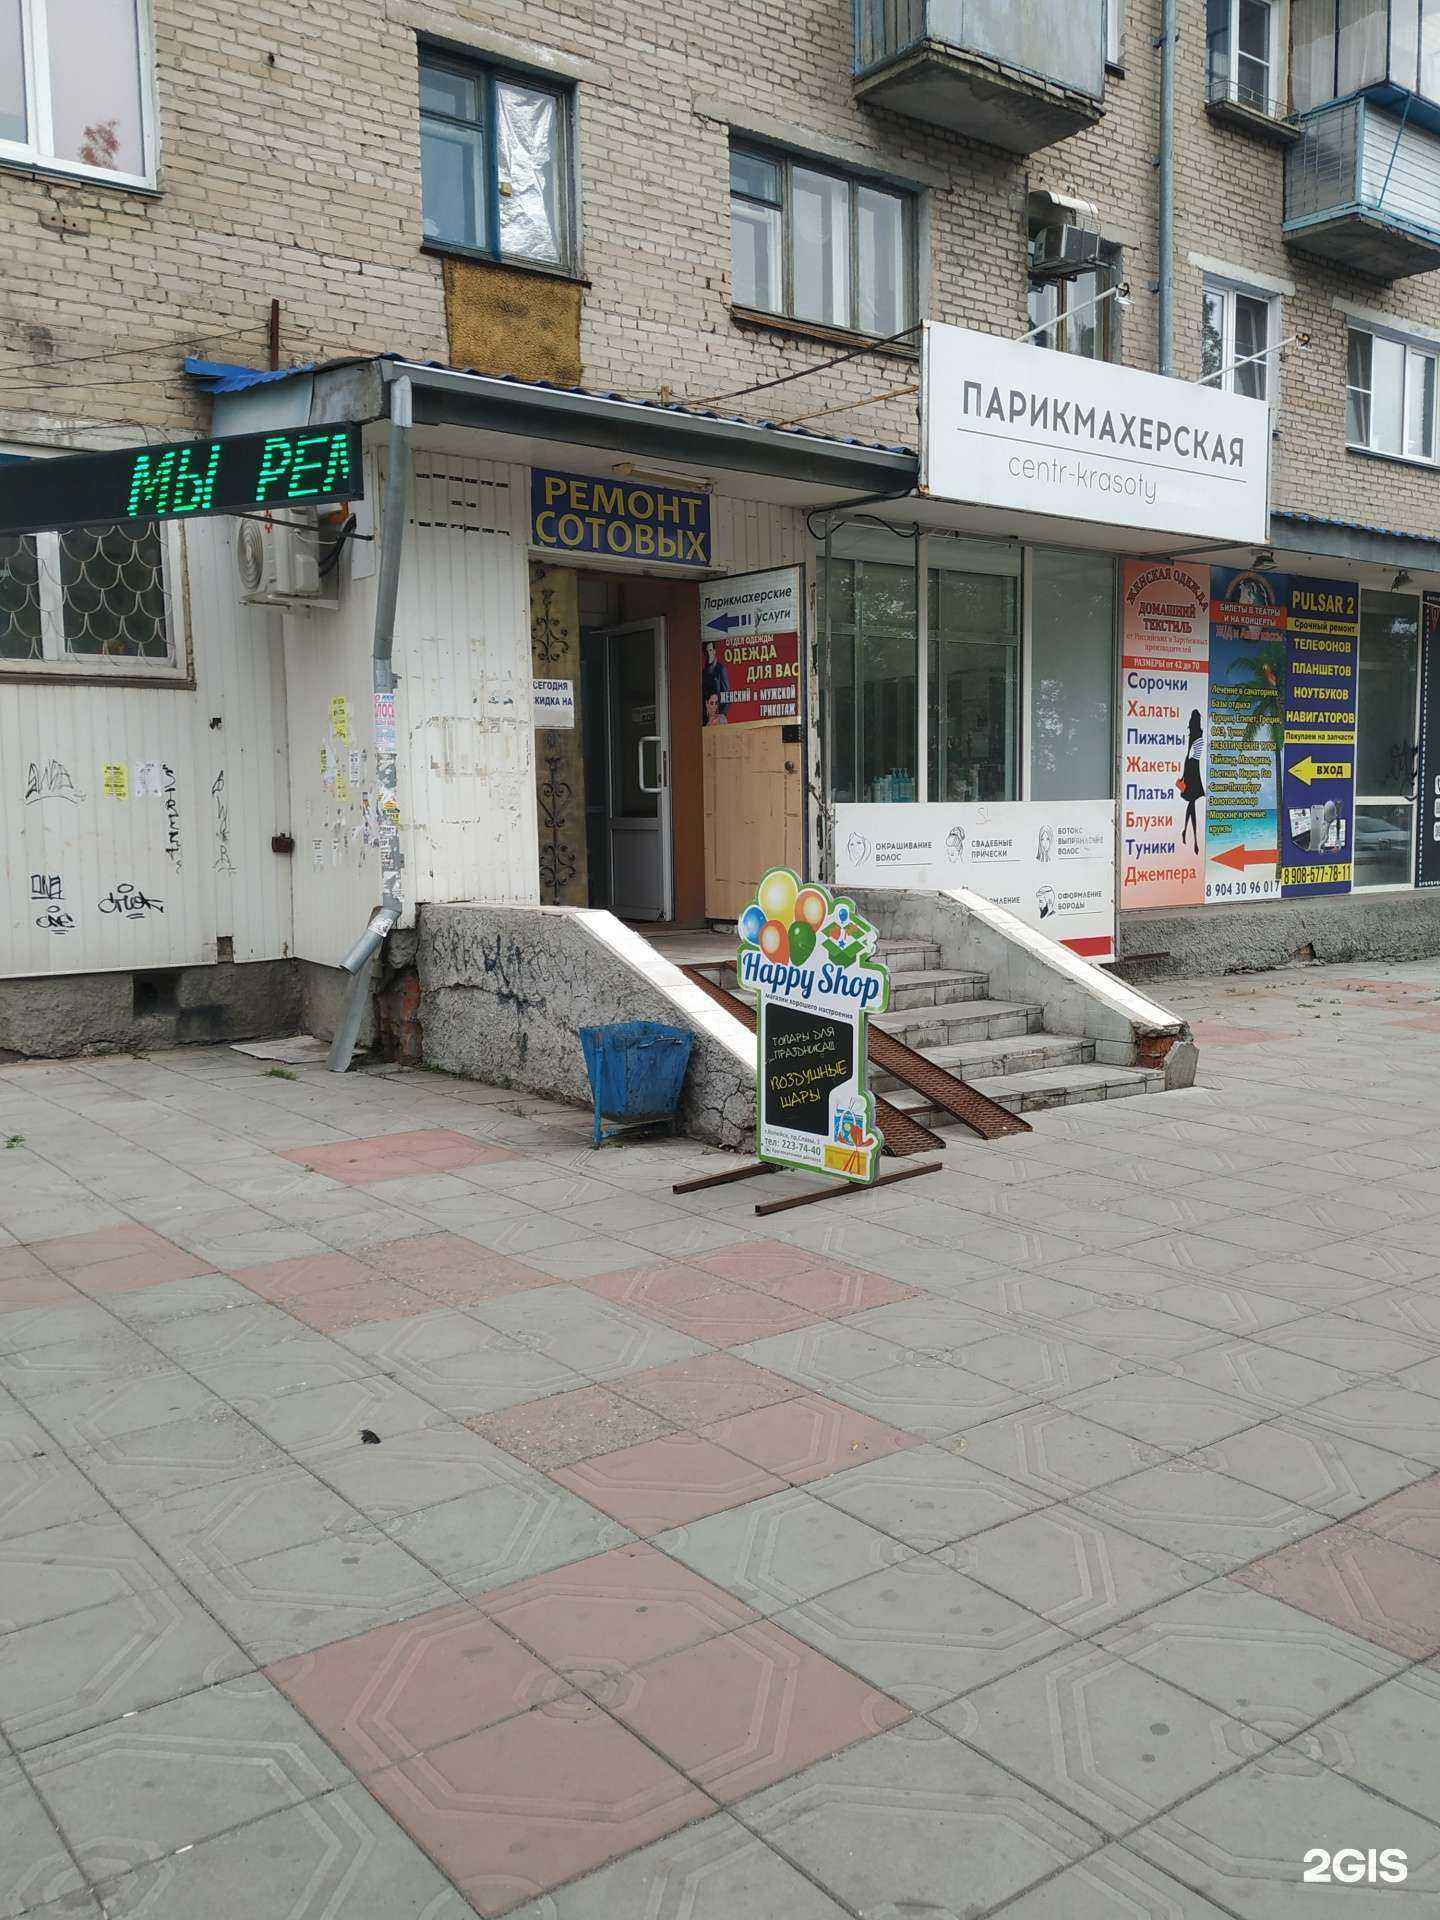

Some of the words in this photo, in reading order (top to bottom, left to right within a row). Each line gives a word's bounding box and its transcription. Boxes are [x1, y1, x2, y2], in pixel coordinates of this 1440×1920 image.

[963, 381, 1245, 468] ПАРИКМАХЕРСКАЯ
[128, 445, 221, 518] МЫ
[1008, 455, 1157, 505] centr-krasoty
[545, 477, 703, 526] РЕМОНТ
[536, 511, 708, 562] СОТОВЫХ
[704, 587, 792, 610] Парикмахерские
[1292, 590, 1344, 614] PULSAR
[1346, 596, 1354, 615] 2
[755, 608, 791, 627] услуги
[1138, 602, 1196, 618] ДОМАШНИЙ
[1220, 603, 1248, 613] БИЛЕТЫ
[1255, 607, 1281, 616] ТЕАТРЫ
[1143, 618, 1193, 634] ТЕКСТИЛЬ
[1295, 619, 1328, 631] Срочный
[1329, 623, 1355, 633] ремонт
[1294, 638, 1352, 653] ТЕЛЕФОНОВ
[724, 645, 777, 665] ОДЕЖДА
[747, 664, 772, 684] ДЛЯ
[776, 662, 800, 678] ВАС
[1292, 662, 1352, 677] ПЛАНШЕТОВ
[532, 680, 568, 691] СЕГОДНЯ
[1128, 672, 1188, 694] Сорочки
[533, 696, 561, 707] КИДКА
[562, 696, 573, 706] НА
[720, 687, 751, 704] ЖЕНСКИЙ
[760, 684, 796, 701] МУЖСКОЙ
[1293, 686, 1350, 700] НОУТБУКОВ
[760, 702, 796, 717] ТРИКОТАЖ
[1127, 700, 1180, 718] Халаты
[1286, 710, 1356, 724] НАВИГАТОРОВ
[1127, 728, 1186, 745] Пижамы
[1286, 731, 1317, 742] Покупаем
[1126, 756, 1181, 773] Жакеты
[1316, 765, 1344, 777] ВХОД
[1126, 783, 1174, 800] Платья
[1125, 811, 1173, 832] Блузки
[875, 841, 933, 851] ОКРАШИВАНИЕ
[971, 839, 1013, 848] СВАДЕБНЫЕ
[1125, 839, 1176, 859] Туники
[875, 853, 902, 862] ВОЛОС
[971, 849, 1008, 858] ПРИЧЕСКИ
[1124, 866, 1197, 886] Джемпера
[1284, 869, 1290, 885] 8
[1291, 865, 1352, 883] 908-577-78-11
[1057, 890, 1103, 899] ОФОРМЛЕНИЕ
[1205, 884, 1211, 897] 8
[1215, 883, 1232, 897] 904
[1235, 882, 1247, 895] 30
[1249, 881, 1261, 893] 96
[1263, 880, 1280, 893] 017
[743, 952, 815, 999] Happy
[817, 962, 880, 1008] Shop
[769, 1059, 848, 1090] ВОЗДУШНЫЕ
[780, 1088, 821, 1109] ШАРЫ
